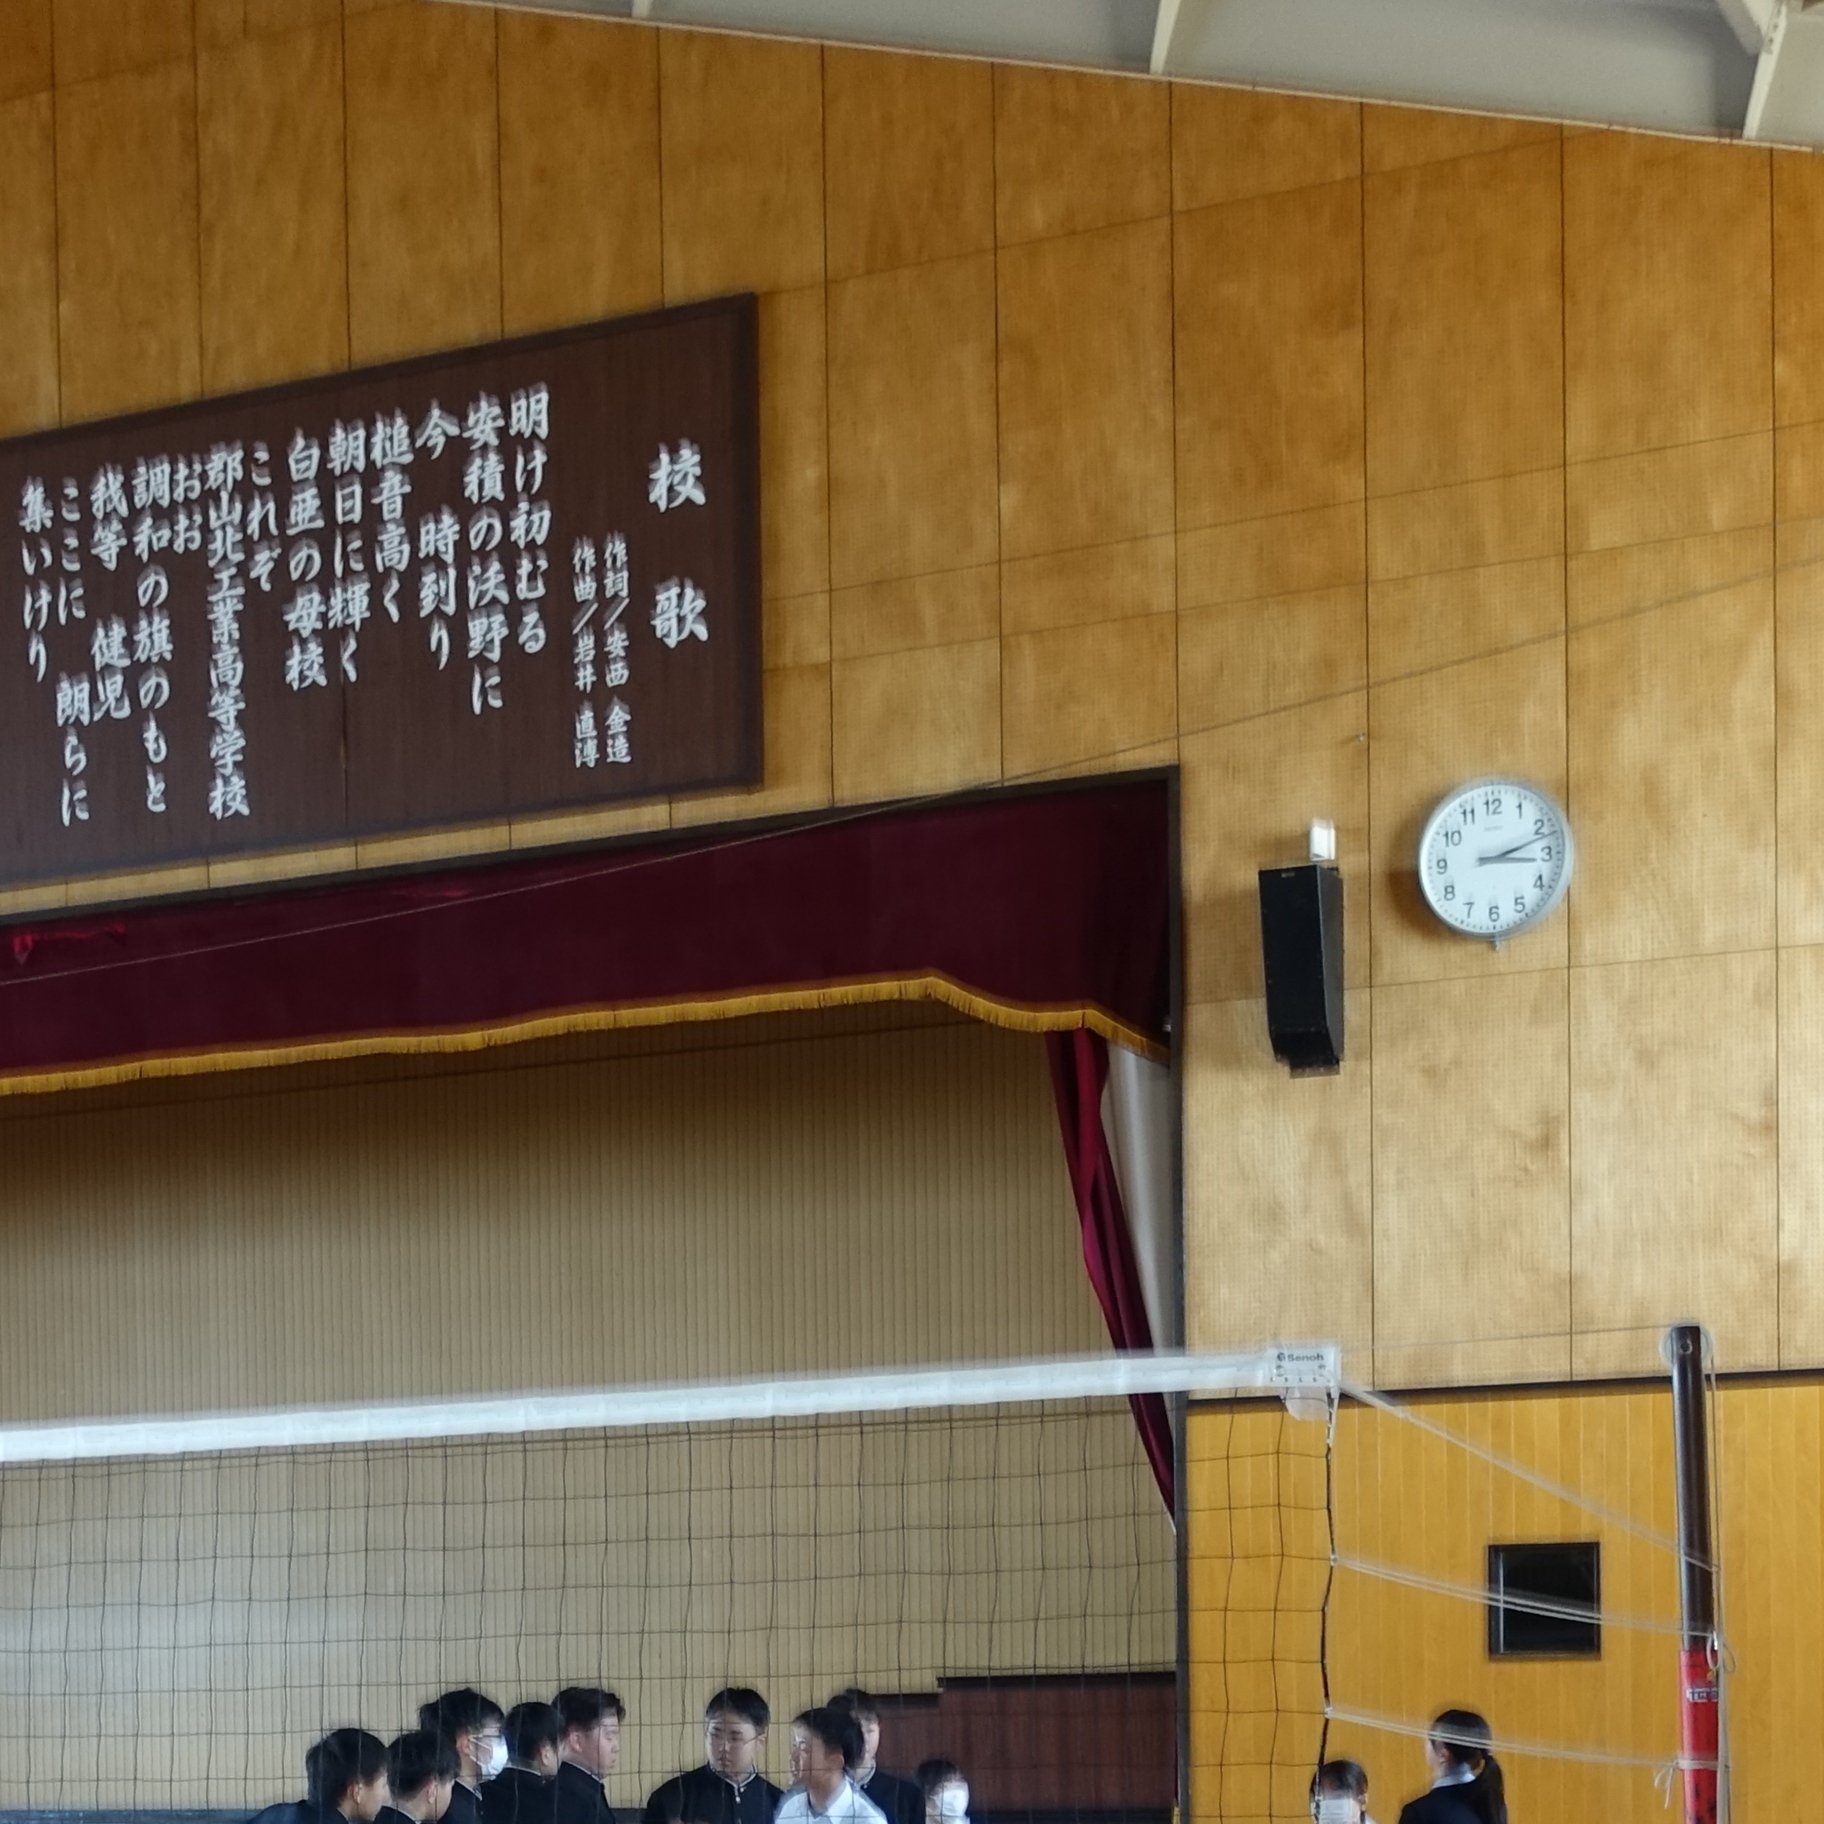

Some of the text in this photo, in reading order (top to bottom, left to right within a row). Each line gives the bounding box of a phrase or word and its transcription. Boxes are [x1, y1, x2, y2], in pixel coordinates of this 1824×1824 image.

[173, 454, 203, 554] おお
[247, 442, 281, 592] これぞ
[509, 384, 551, 654] 明け初むる
[284, 429, 327, 691] 白亜の母校
[327, 421, 371, 682] 朝日に輝く
[463, 393, 509, 715] 安積の沃野に
[20, 477, 53, 682] 集いけり
[131, 456, 173, 813] 調和の旗のもと
[204, 442, 249, 820] 郡山北工業高等学校
[604, 698, 631, 764] 金造
[1483, 798, 1502, 816] 12
[1460, 808, 1475, 825] 11
[1533, 819, 1545, 836] 2
[1442, 830, 1462, 848] 10
[1541, 846, 1553, 862] 3
[1436, 859, 1448, 875] 9
[1533, 874, 1545, 891] 4
[1443, 885, 1455, 901] 8
[1464, 902, 1475, 919] 7
[1488, 906, 1500, 922] 6
[1514, 896, 1526, 914] 5
[1287, 1352, 1324, 1361] Senoh
